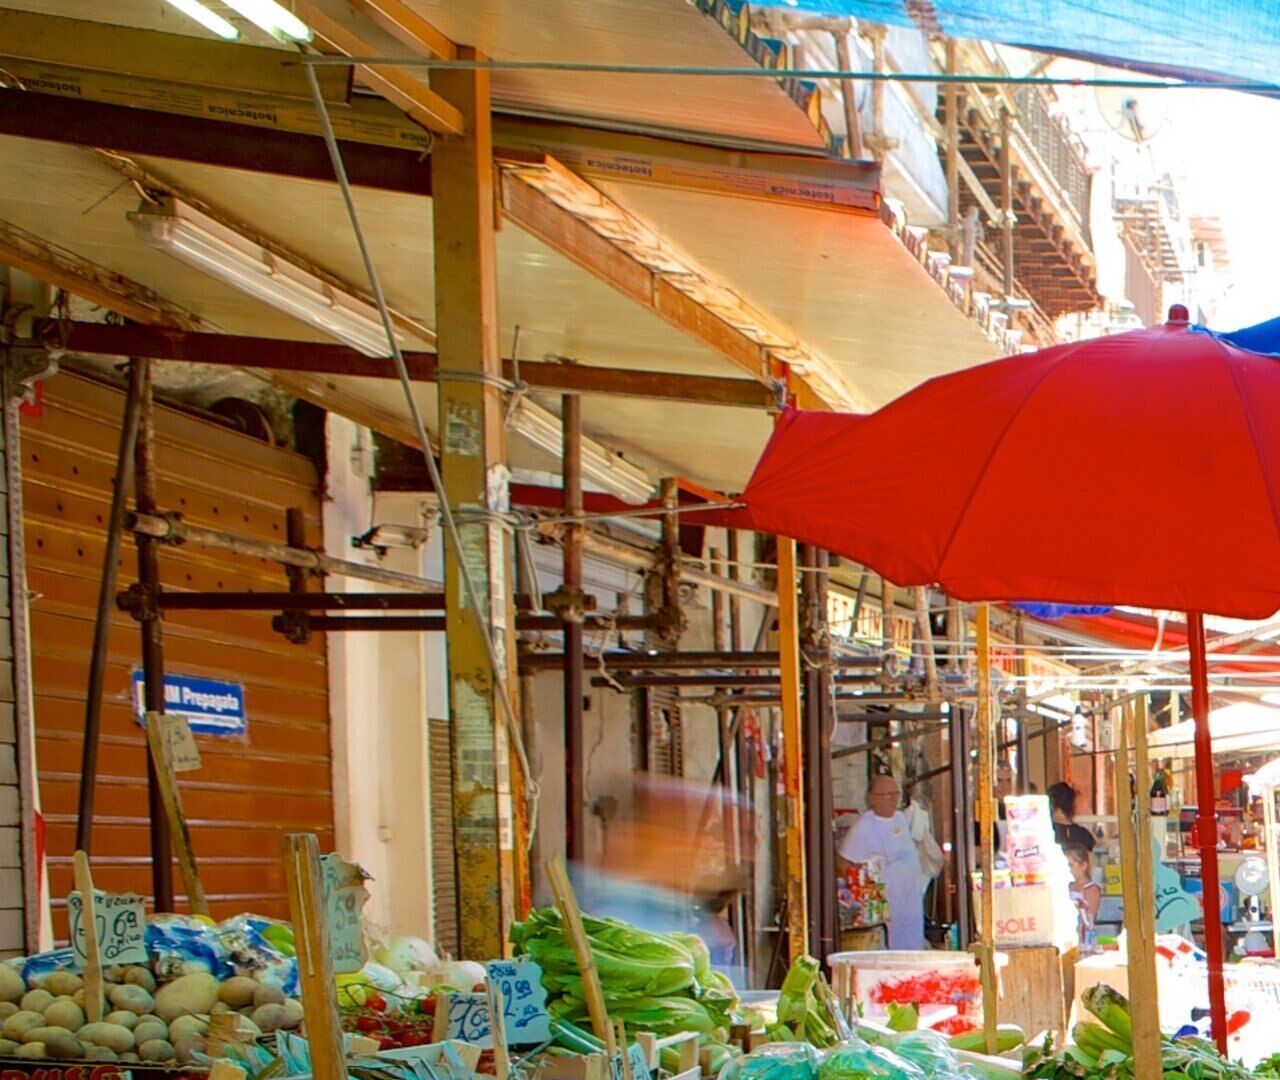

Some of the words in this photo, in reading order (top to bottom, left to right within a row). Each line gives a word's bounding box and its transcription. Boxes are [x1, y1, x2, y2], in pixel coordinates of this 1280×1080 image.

[208, 104, 278, 123] Isotecnica
[586, 158, 653, 177] Isotecnica
[770, 183, 835, 202] Isotecnica
[182, 686, 240, 712] Prepagata
[996, 917, 1037, 934] SOLE
